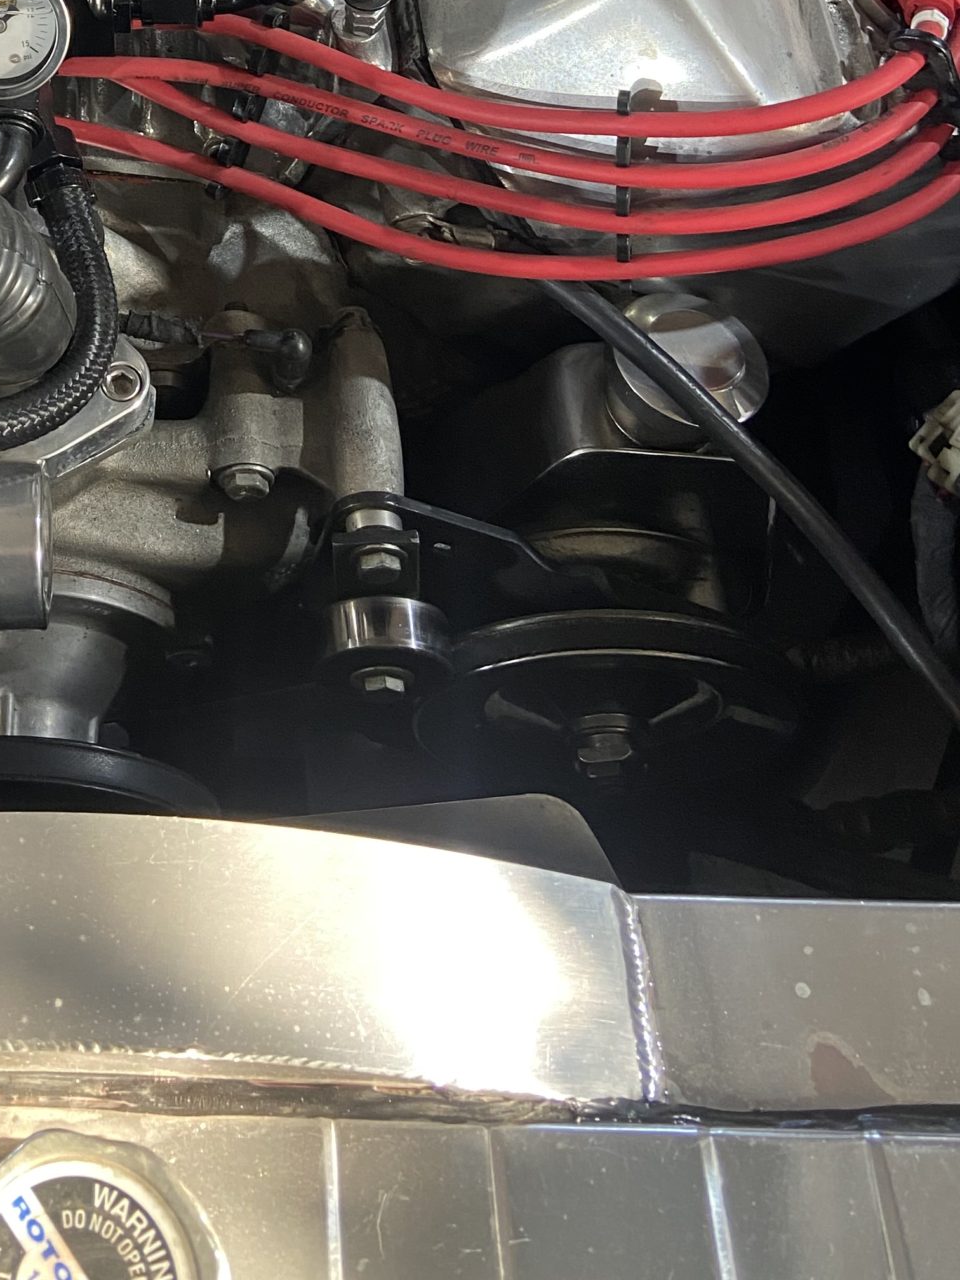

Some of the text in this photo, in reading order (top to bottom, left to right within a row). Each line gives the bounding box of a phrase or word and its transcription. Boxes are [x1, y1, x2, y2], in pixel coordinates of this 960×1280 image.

[272, 91, 350, 119] CONDUCTOR
[416, 129, 452, 146] PLUG
[465, 140, 500, 157] WIRE
[62, 1209, 149, 1280] DO NOT OPE
